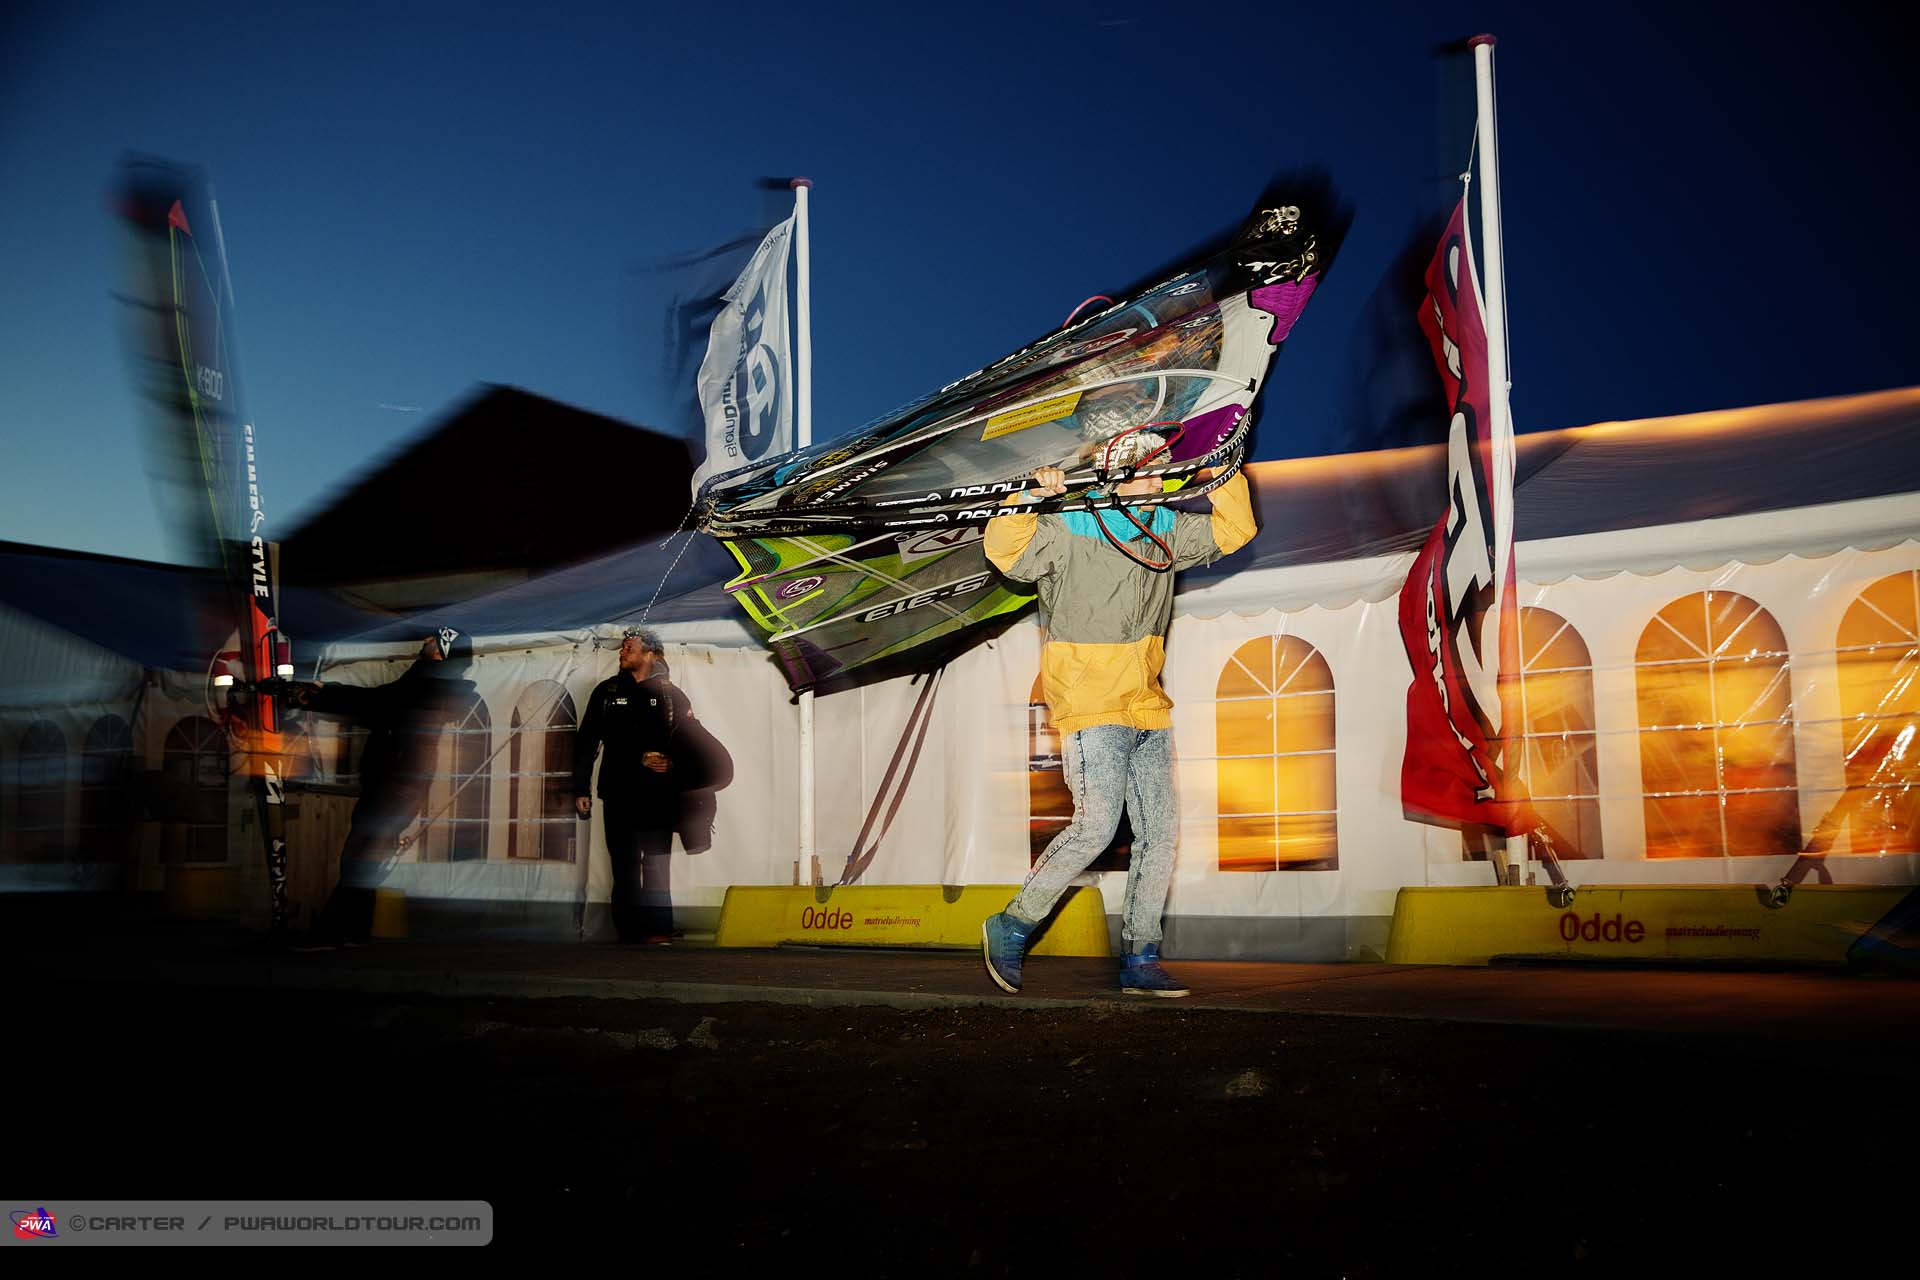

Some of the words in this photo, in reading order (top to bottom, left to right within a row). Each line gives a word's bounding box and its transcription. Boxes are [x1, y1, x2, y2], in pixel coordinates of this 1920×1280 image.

[808, 458, 890, 506] SIMMER
[251, 535, 270, 599] STYLE
[801, 906, 854, 930] Odde
[1559, 911, 1646, 943] Odde
